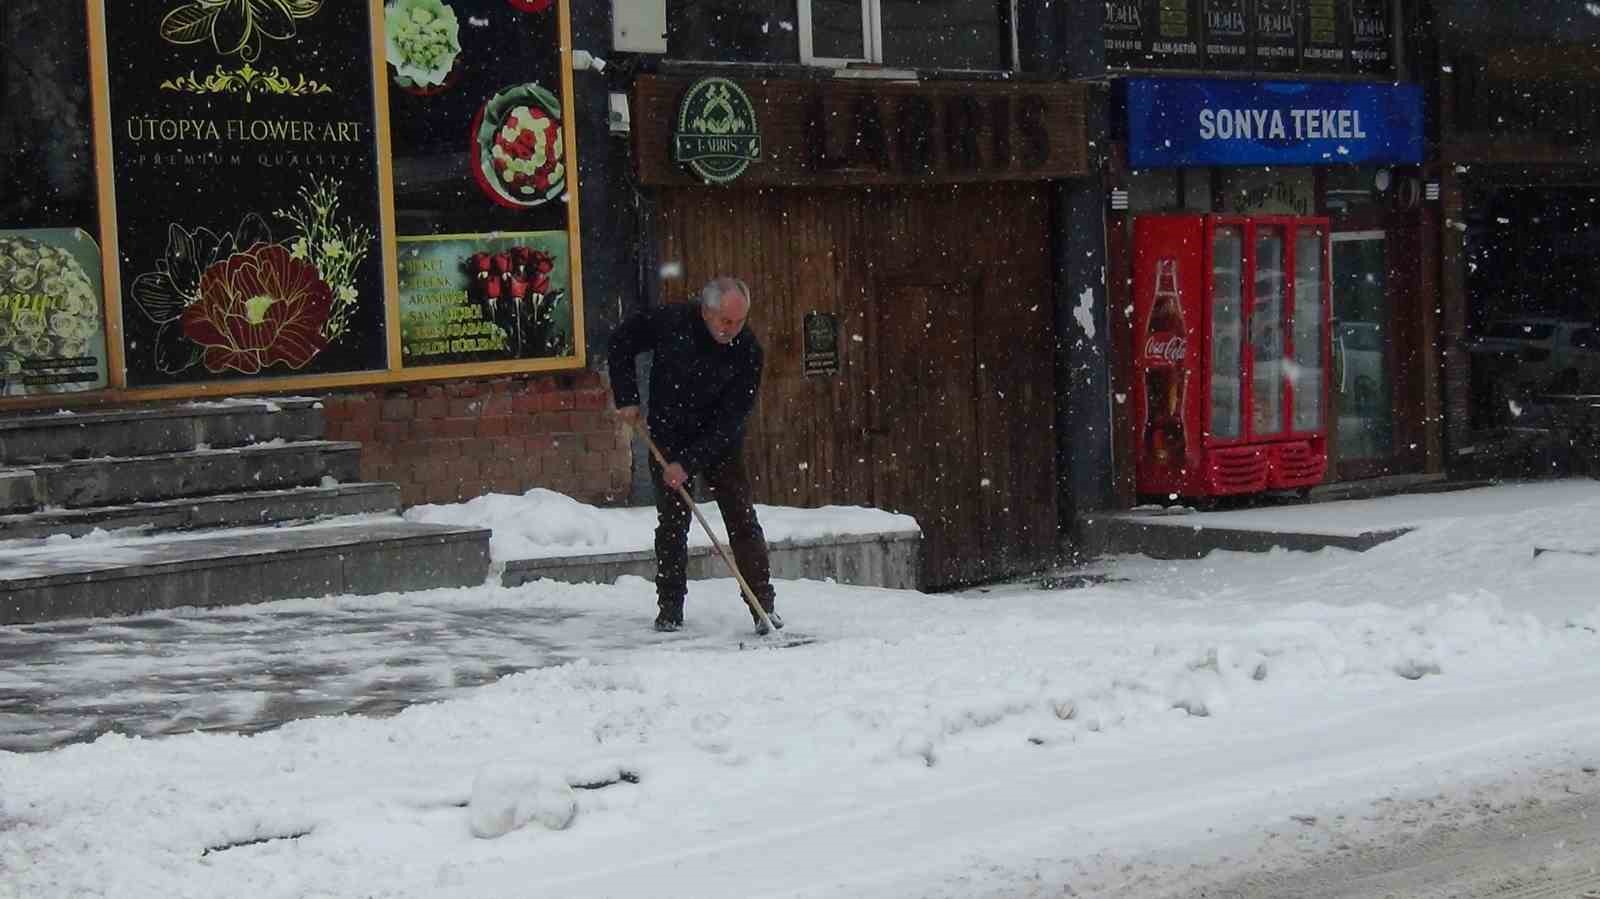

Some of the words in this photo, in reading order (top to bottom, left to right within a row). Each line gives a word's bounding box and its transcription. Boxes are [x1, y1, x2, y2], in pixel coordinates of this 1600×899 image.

[127, 115, 219, 141] ÜTOPYA
[226, 119, 313, 141] FLOWER
[323, 121, 362, 142] ART
[1199, 109, 1284, 140] SONYA
[1290, 109, 1366, 139] TEKEL
[137, 152, 240, 167] PREMIUM
[258, 152, 351, 168] QUALITY
